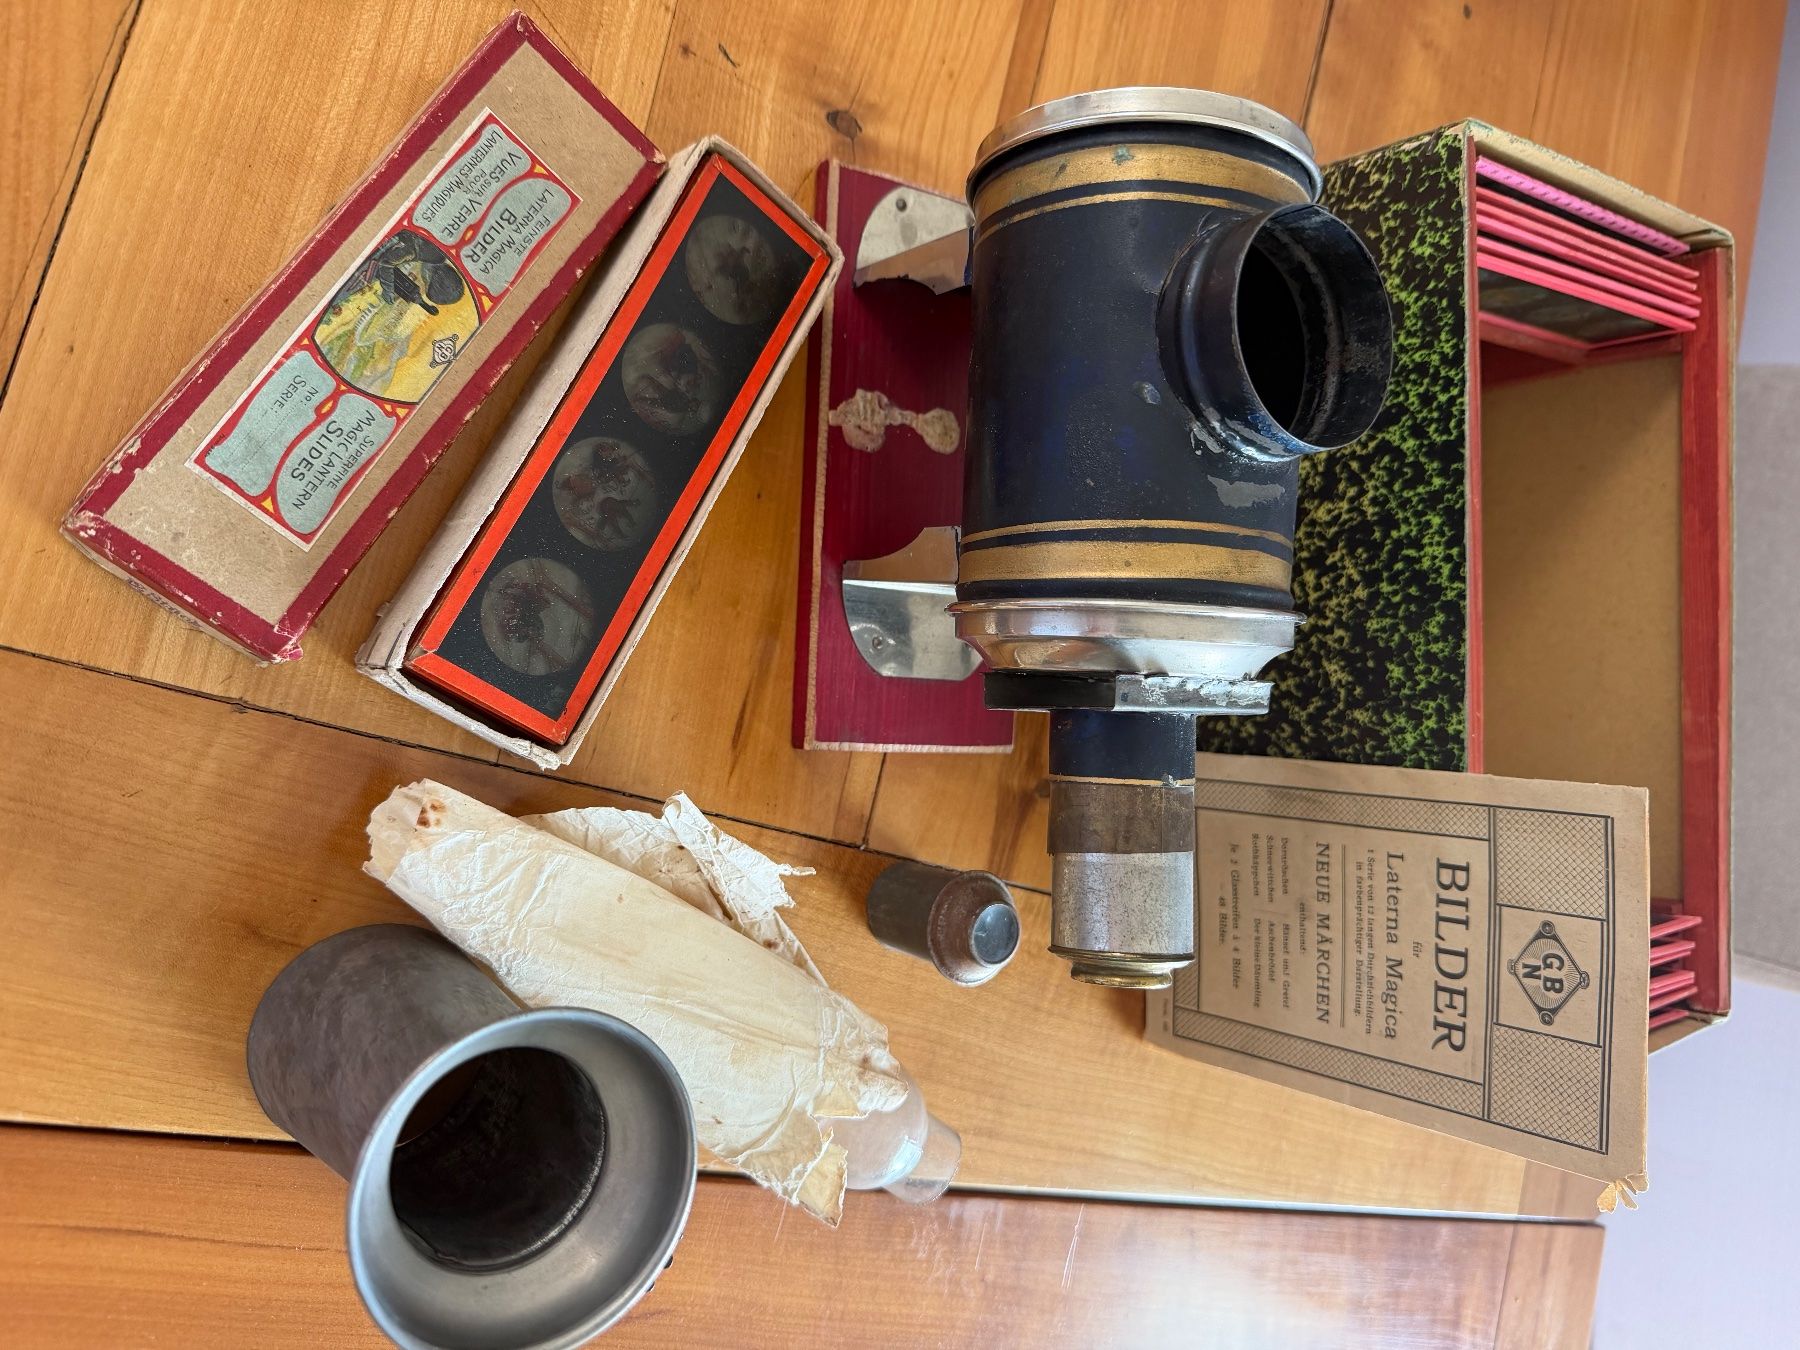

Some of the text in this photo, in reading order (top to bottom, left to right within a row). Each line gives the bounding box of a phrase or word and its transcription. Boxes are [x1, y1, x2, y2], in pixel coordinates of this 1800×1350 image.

[459, 130, 504, 179] LANTERNES
[489, 151, 522, 184] VUES
[462, 168, 488, 195] POUR
[441, 198, 483, 238] VERRE
[465, 207, 518, 263] BILDER
[479, 188, 555, 275] LATERNA MAGICA
[513, 214, 551, 257] FEINSTE
[290, 420, 344, 482] SLIDES
[291, 409, 376, 511] MAGIC LANTERN
[326, 435, 375, 490] SUPERFINE
[1355, 861, 1364, 871] in
[1366, 856, 1375, 881] Serie
[1353, 875, 1364, 955] farbenprächtiger
[1366, 883, 1374, 902] von
[1367, 905, 1375, 915] 12
[1315, 841, 1333, 1025] NEUE MÄRCHEN
[1365, 917, 1375, 949] langen
[1380, 851, 1405, 1040] Laterna Magica
[1412, 939, 1423, 959] für
[1431, 856, 1470, 1052] BILDER
